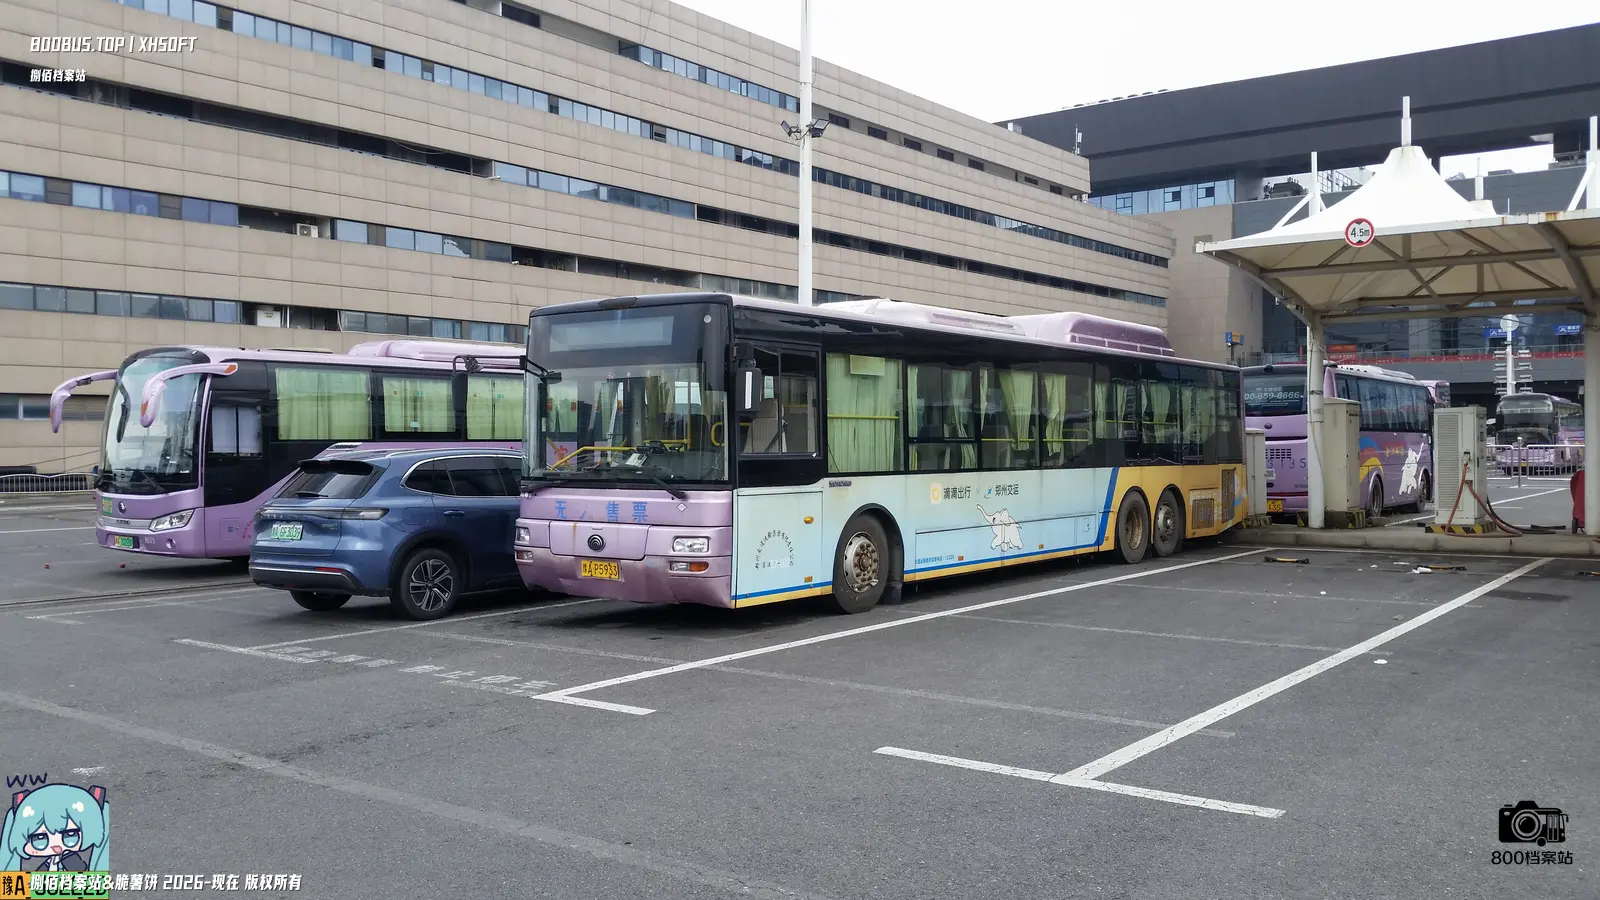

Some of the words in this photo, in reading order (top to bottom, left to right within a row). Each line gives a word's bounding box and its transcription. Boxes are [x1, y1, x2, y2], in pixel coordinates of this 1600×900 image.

[1350, 227, 1370, 238] 4.5m
[943, 486, 971, 500] 滴滴出行
[995, 484, 1019, 497] 郑州交运
